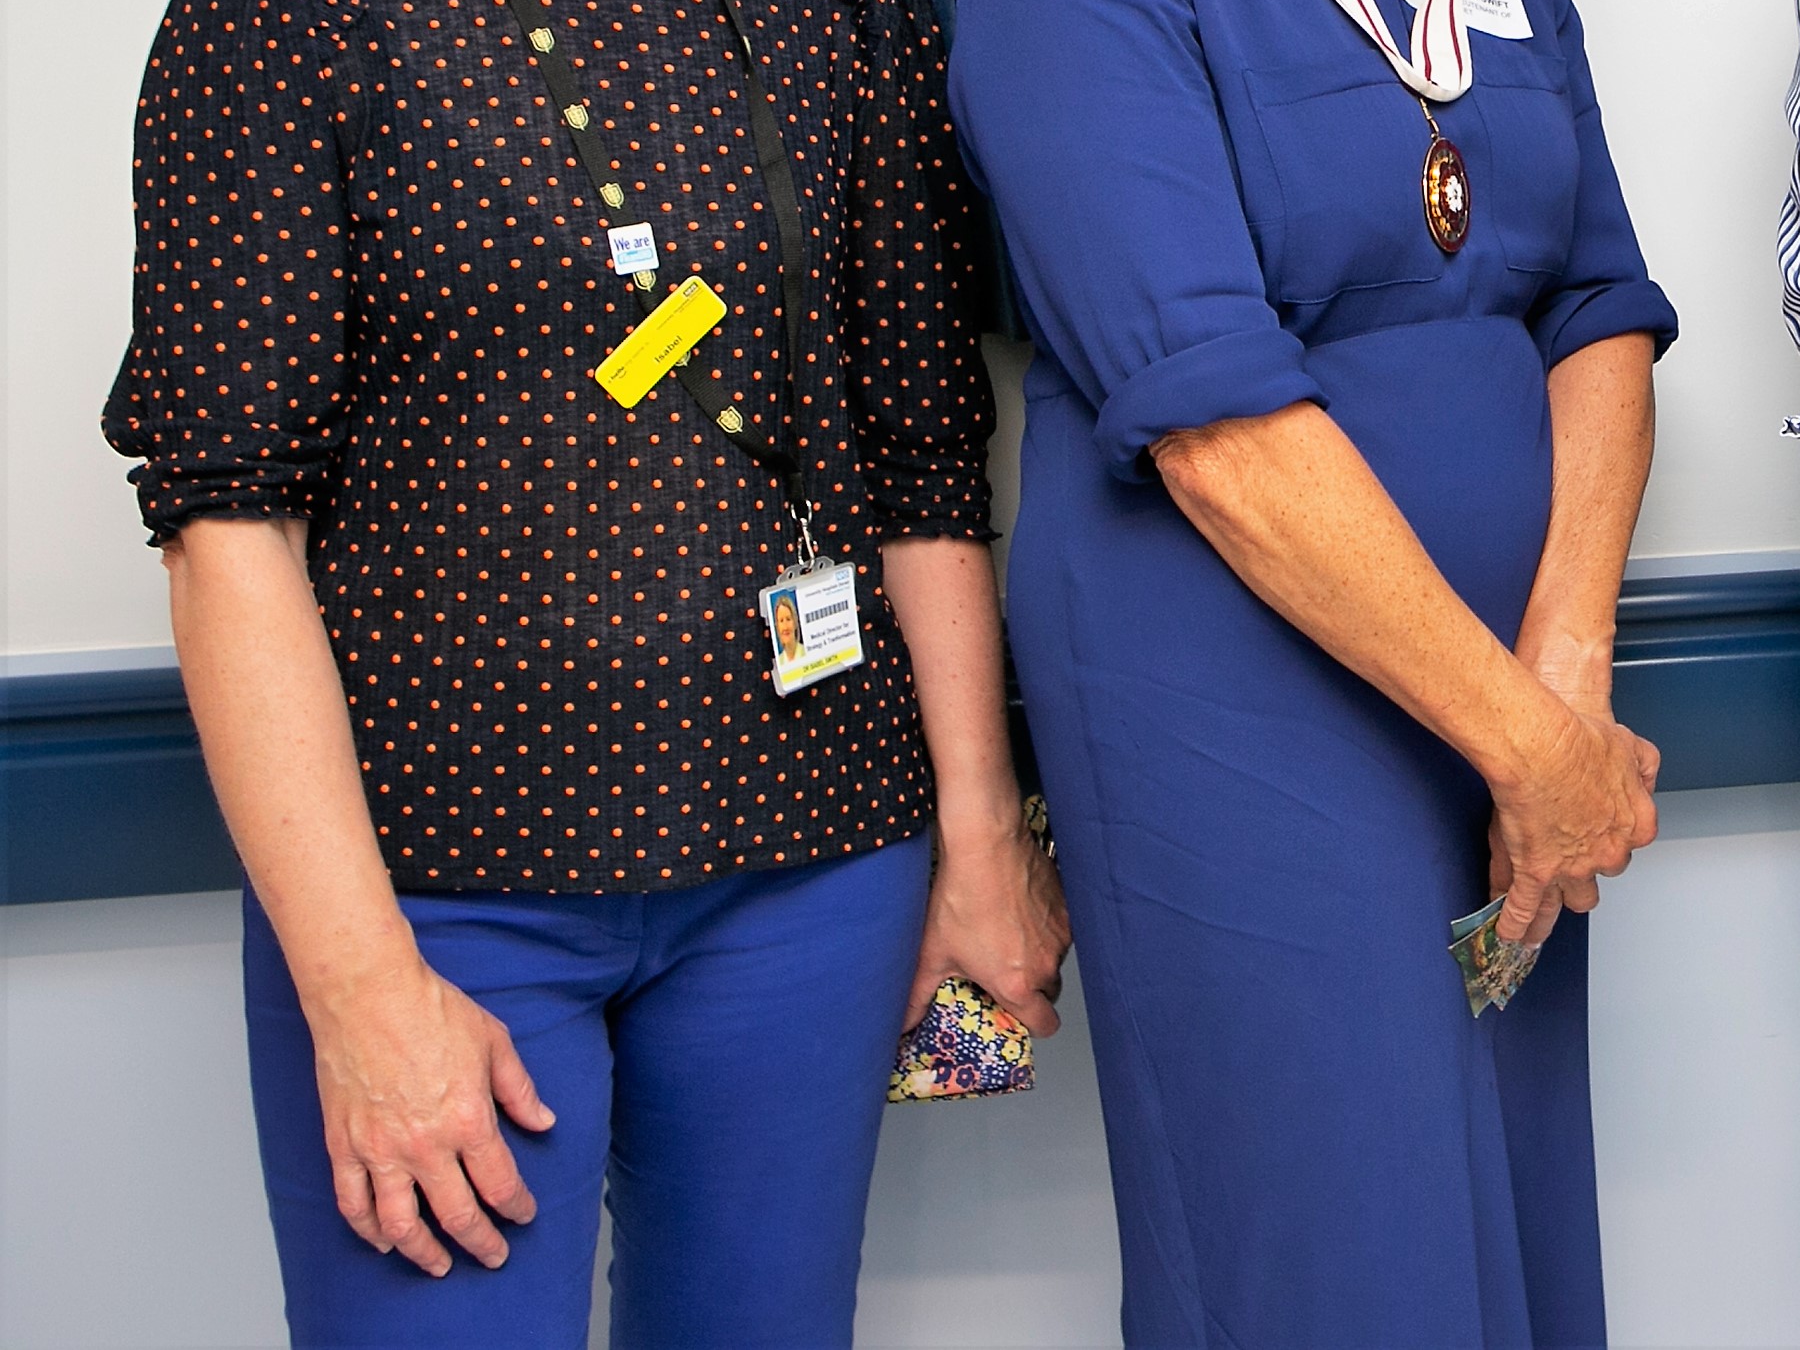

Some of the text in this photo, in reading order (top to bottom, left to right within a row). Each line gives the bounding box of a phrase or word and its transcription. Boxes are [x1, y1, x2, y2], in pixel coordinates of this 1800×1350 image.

[614, 235, 651, 252] We are
[654, 334, 684, 364] Isabel
